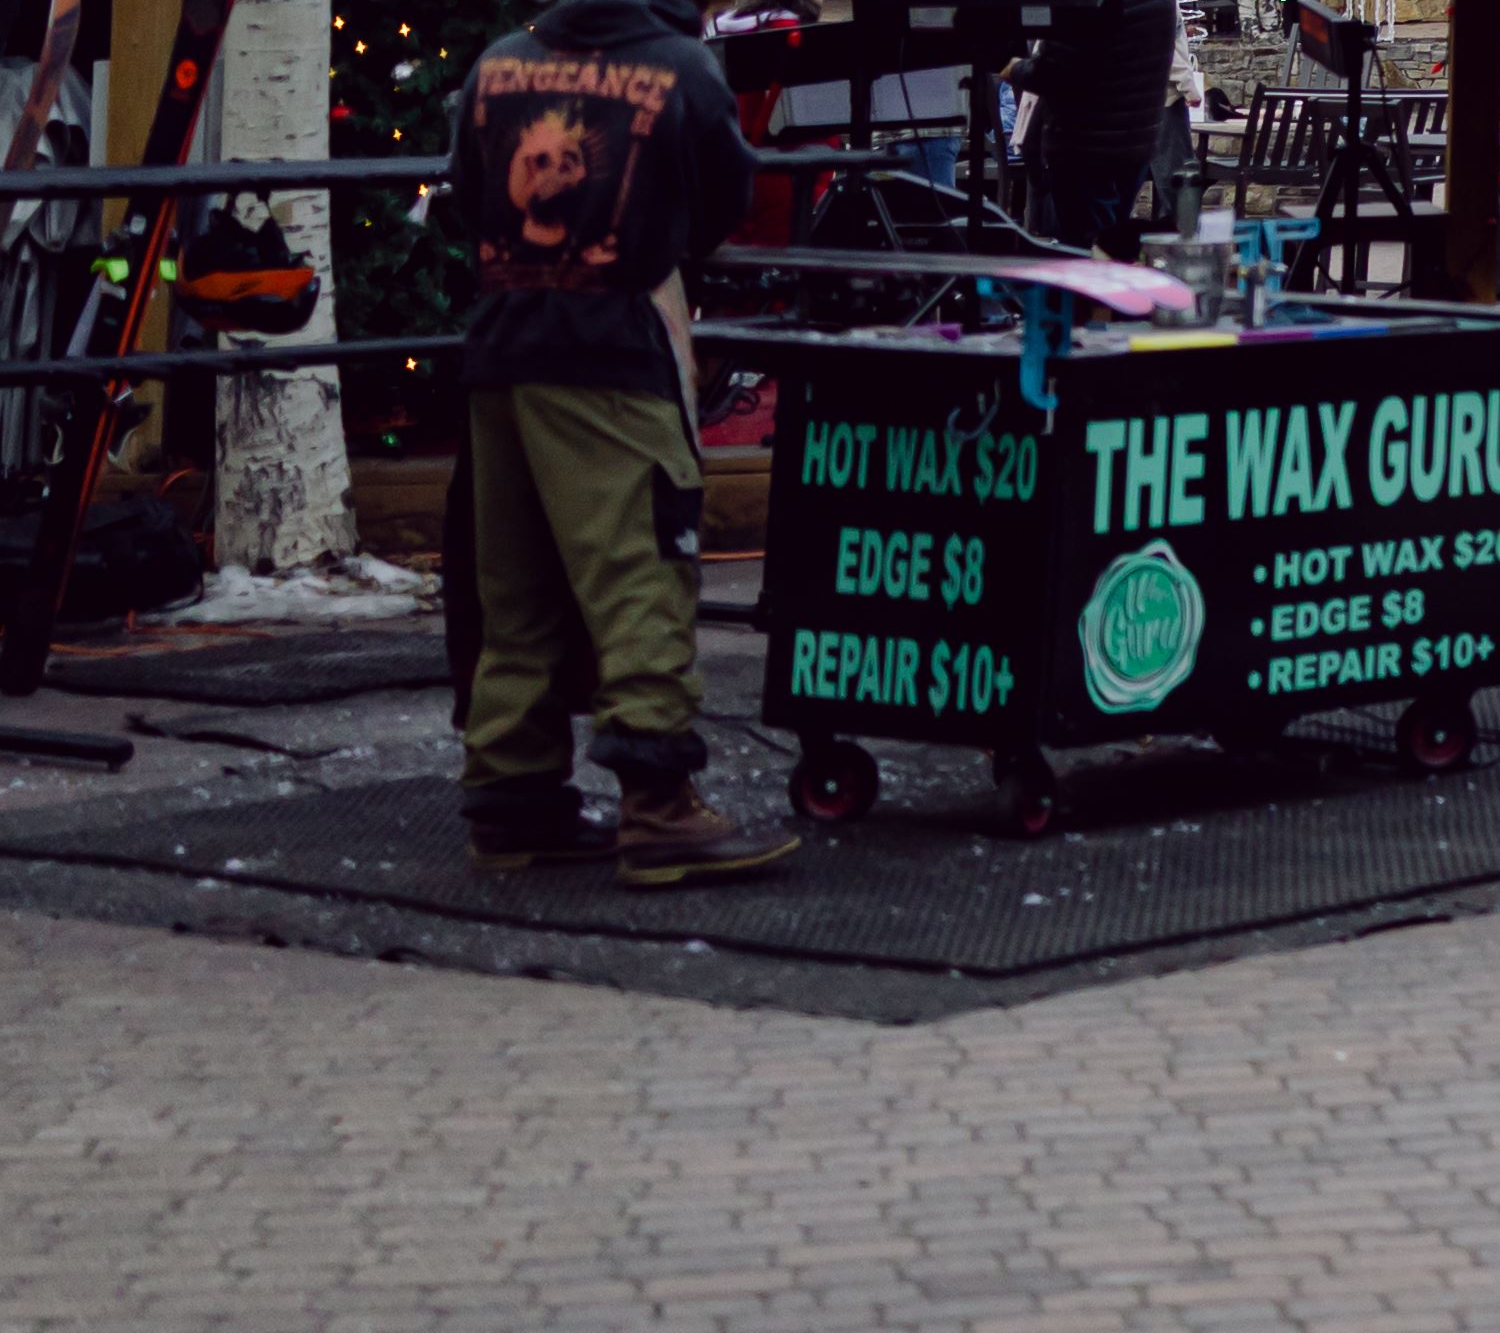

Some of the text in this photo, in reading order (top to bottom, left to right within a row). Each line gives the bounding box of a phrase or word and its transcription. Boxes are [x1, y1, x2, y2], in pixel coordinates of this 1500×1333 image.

[802, 420, 1038, 505] HOT WAX $20
[1085, 413, 1209, 534] THE
[1226, 400, 1358, 520] WAX
[835, 527, 985, 610] EDGE $8
[1274, 544, 1353, 589] HOT
[1361, 534, 1445, 579] WAX
[1271, 588, 1425, 642] EDGE $8
[791, 628, 1015, 718] REPAIR $10+
[1268, 632, 1495, 695] REPAIR $10+
